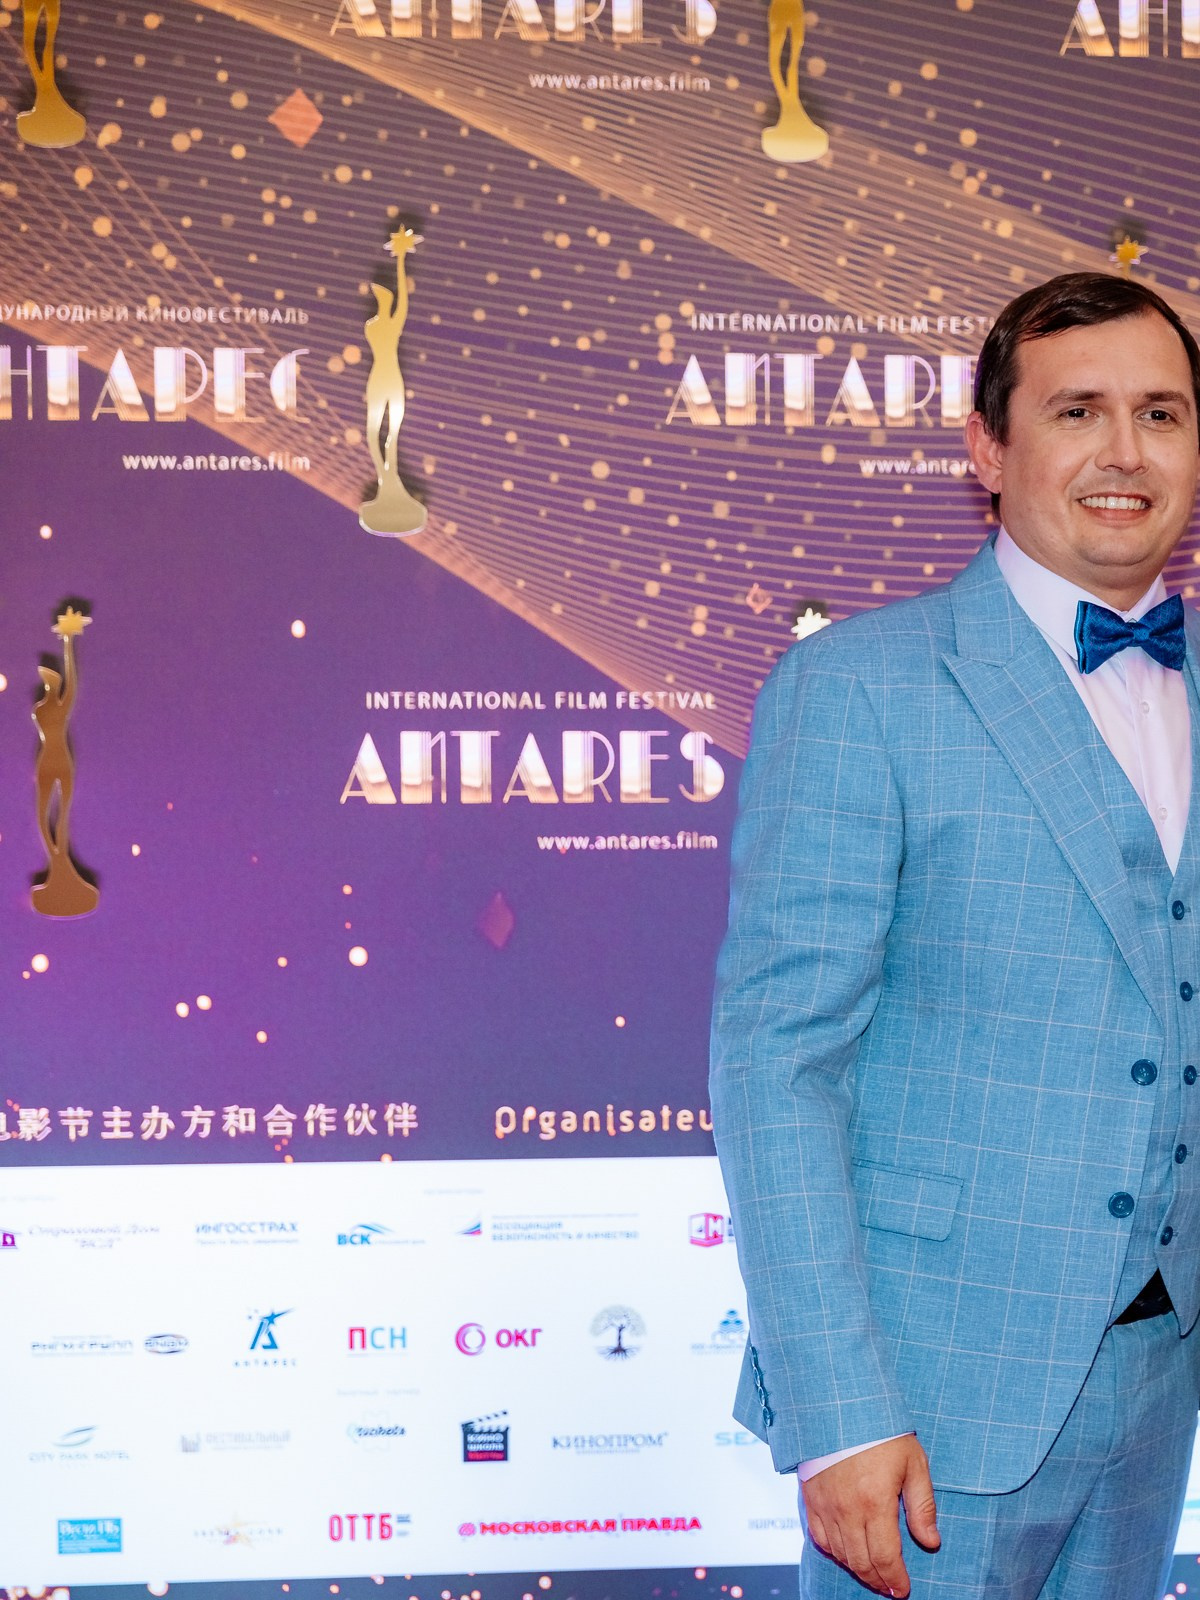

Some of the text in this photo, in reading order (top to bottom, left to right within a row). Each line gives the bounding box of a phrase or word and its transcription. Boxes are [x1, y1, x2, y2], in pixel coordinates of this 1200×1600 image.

[528, 71, 711, 92] www.antares.film
[0, 304, 310, 325] УНАРОДНЫЙ КИНОФЕСТИВАЛЬ
[691, 313, 995, 335] INTERNATIONAL FILM FESTI
[665, 352, 979, 428] ANTARE
[121, 451, 311, 471] www.antares.film
[365, 691, 718, 710] INTERNATIONAL FILM FESTIVAL
[339, 730, 726, 805] ANTARES
[537, 830, 719, 851] www.antares.film
[0, 1102, 419, 1142] 影节主办方和合作伙伴
[494, 1104, 715, 1140] Organisateu
[195, 1221, 298, 1235] ИНГОССТРАХ
[348, 1326, 407, 1350] ПСН
[494, 1327, 543, 1348] ОКГ
[328, 1513, 393, 1542] ОТТБ
[480, 1517, 702, 1535] МОСКОВСКАЯ ПРАВДА
